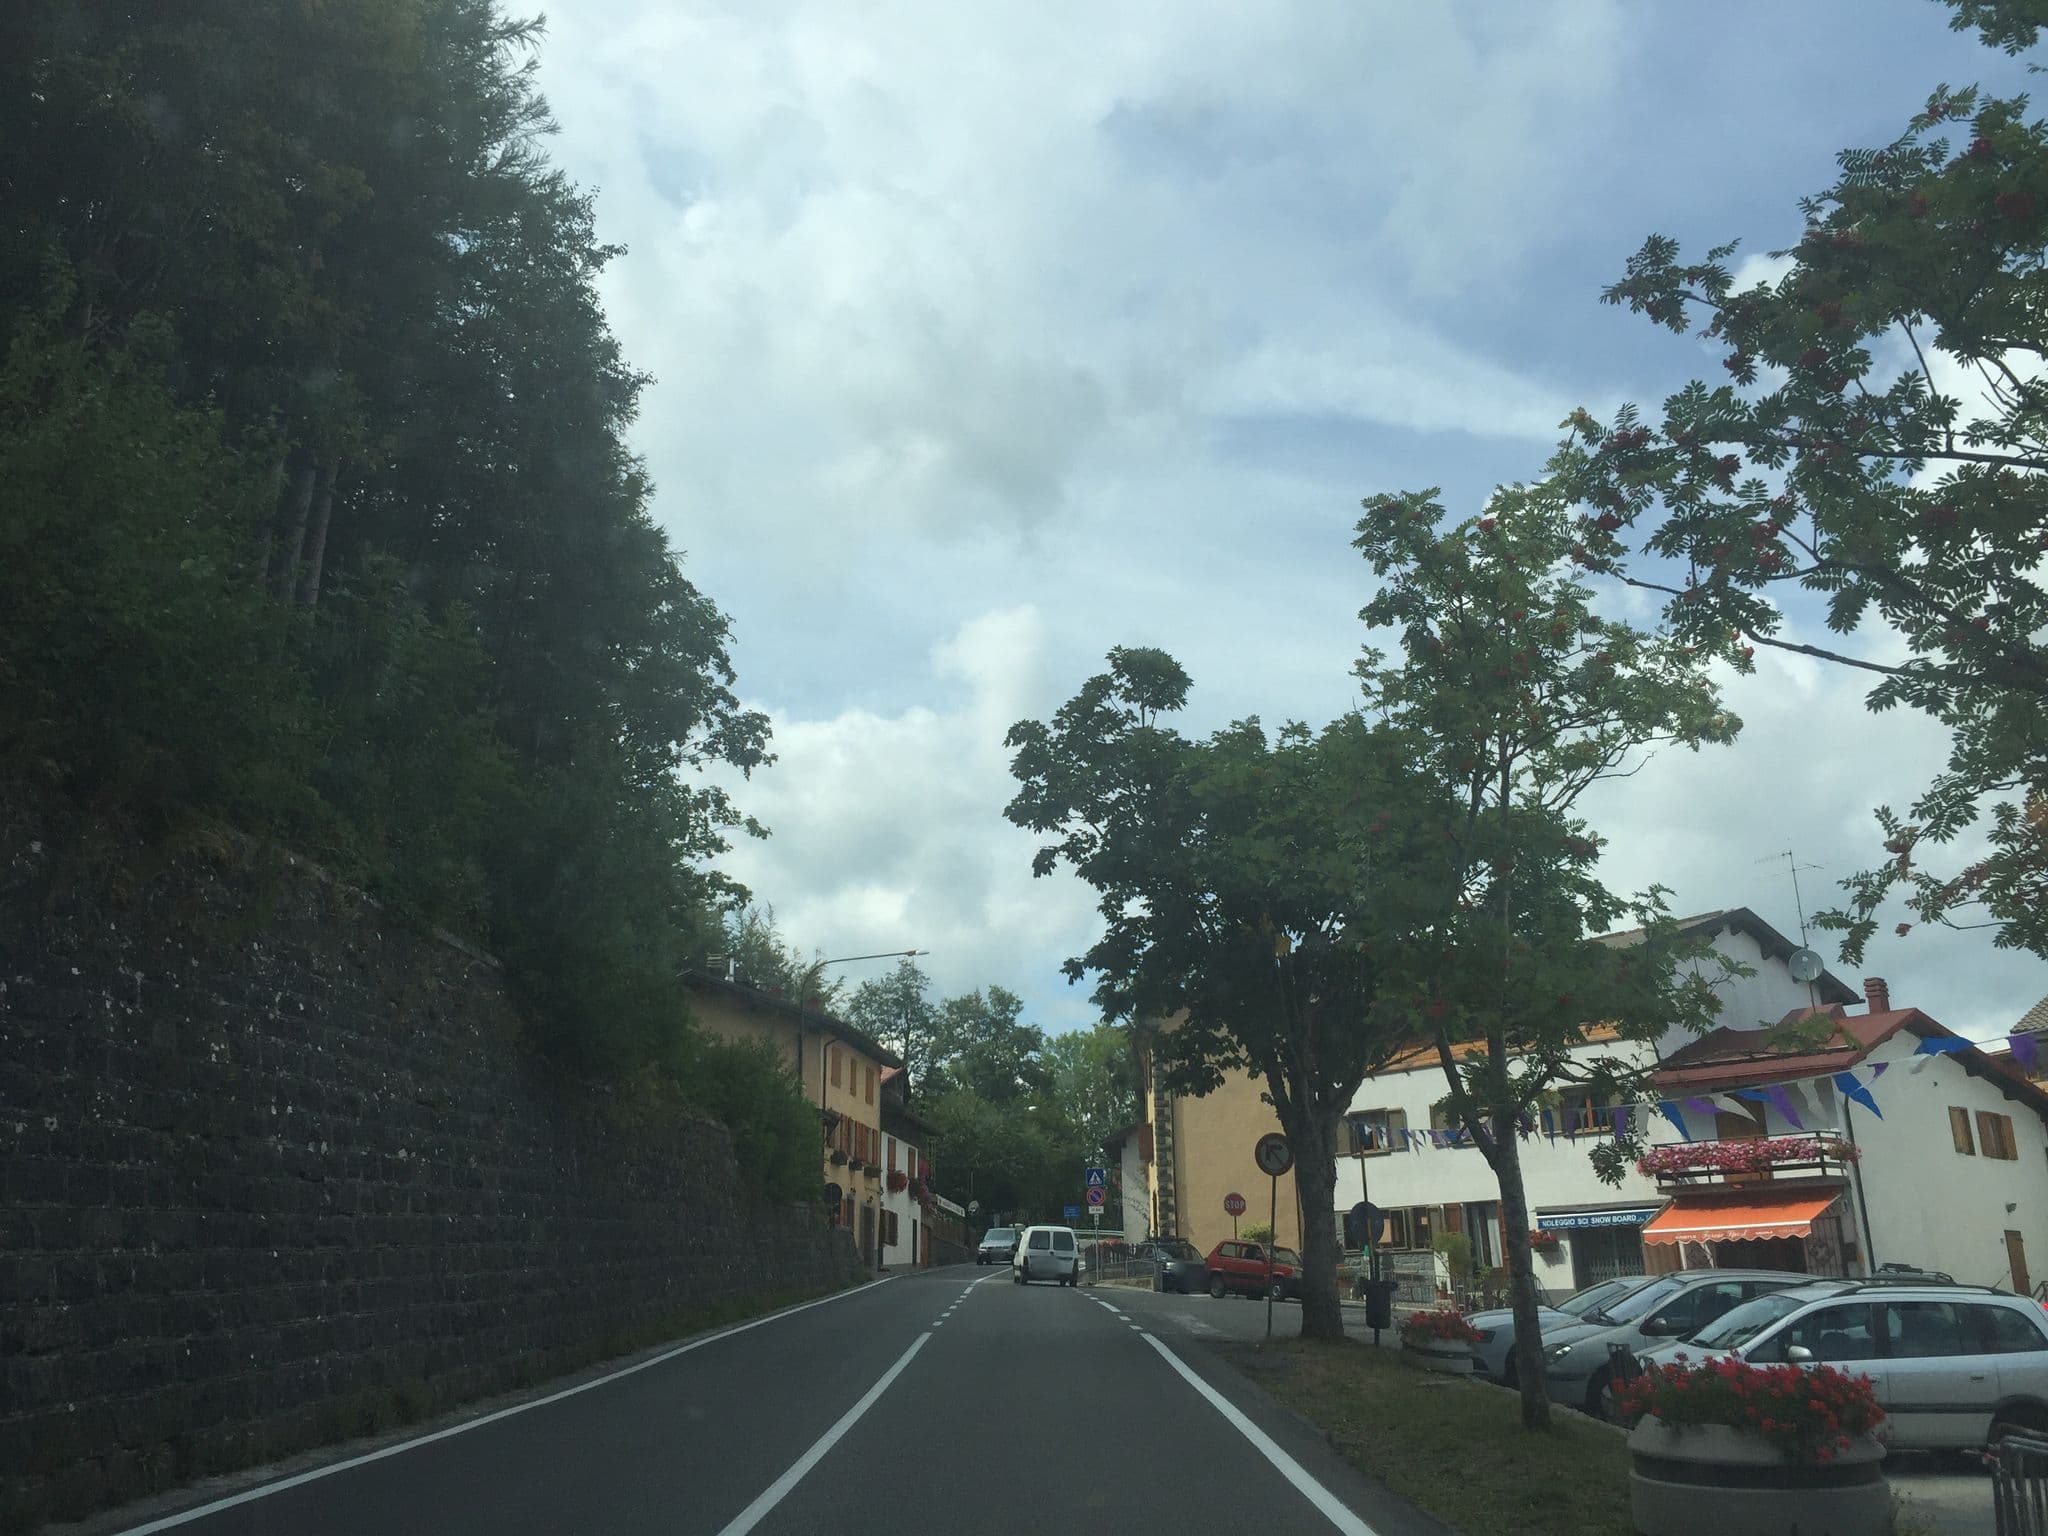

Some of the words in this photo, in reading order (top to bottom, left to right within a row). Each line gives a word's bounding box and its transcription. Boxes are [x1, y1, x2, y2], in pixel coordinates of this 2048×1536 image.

[1225, 1200, 1244, 1209] STOP
[1542, 1218, 1575, 1227] NOLEGGIO
[1578, 1217, 1589, 1225] SCI
[1591, 1216, 1611, 1224] SNOW
[1612, 1214, 1637, 1223] BOARD
